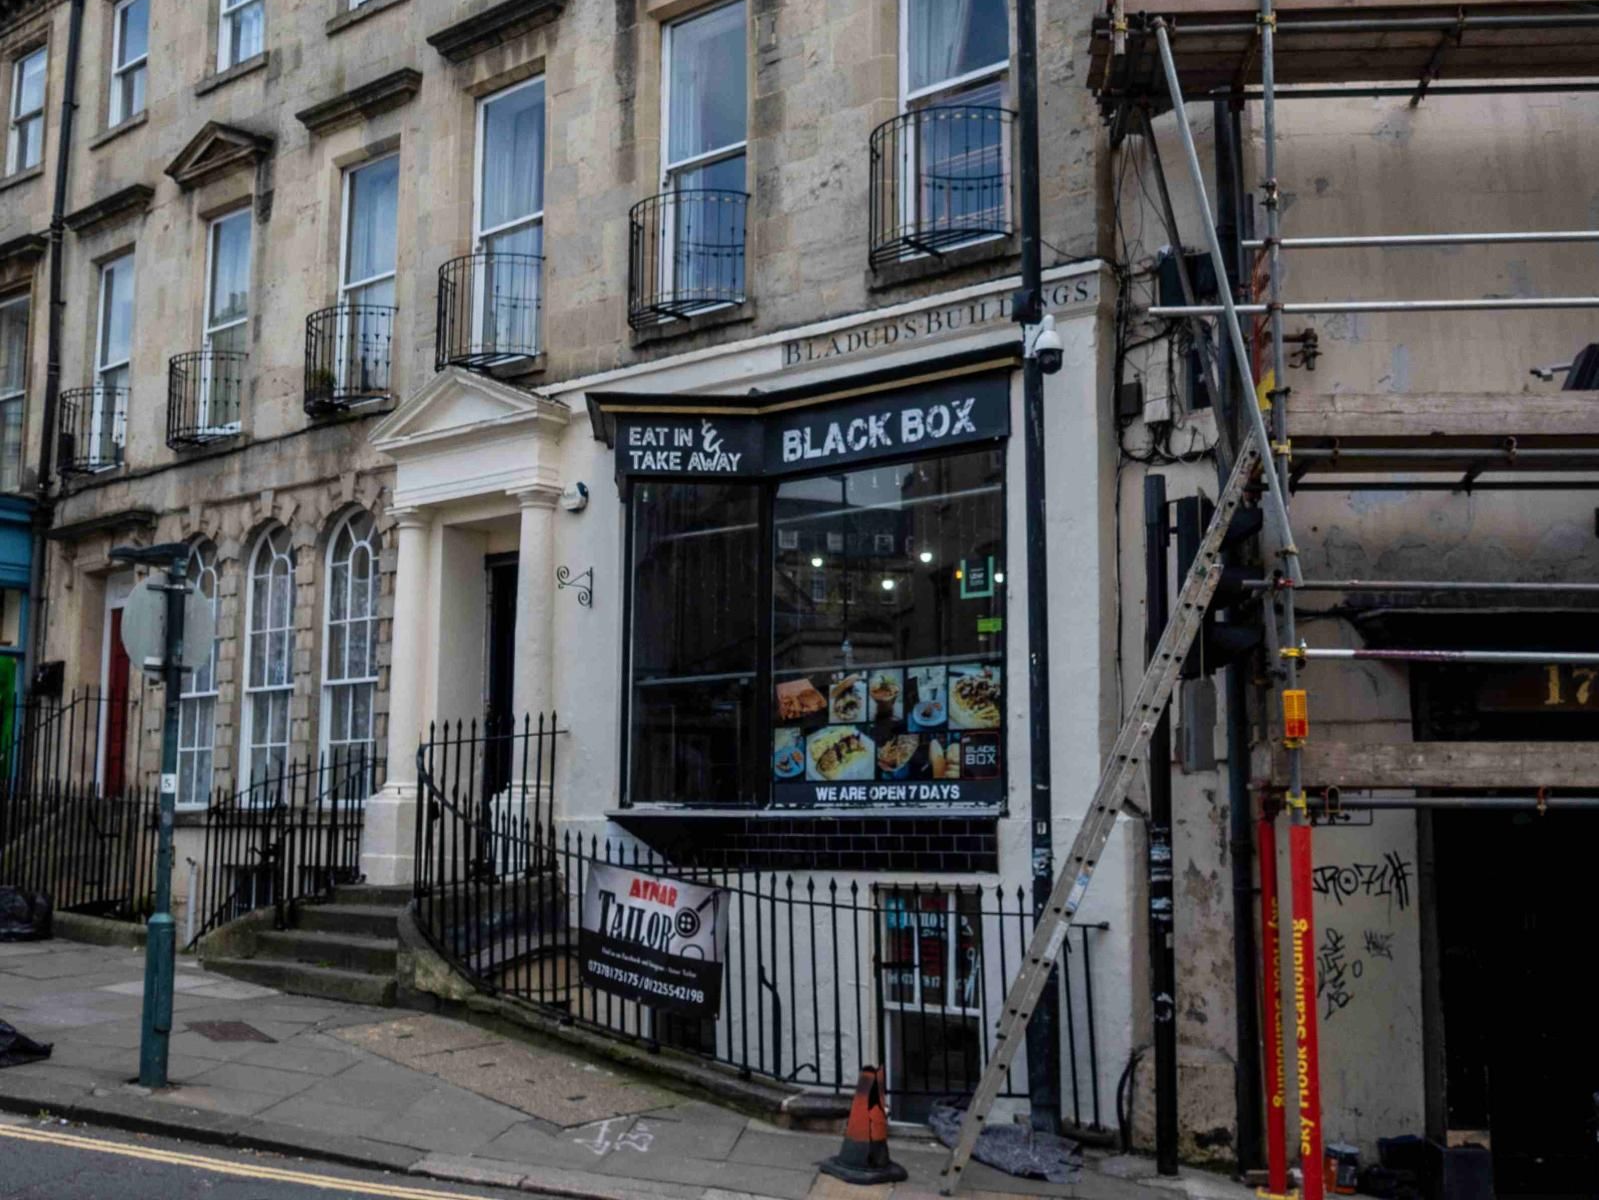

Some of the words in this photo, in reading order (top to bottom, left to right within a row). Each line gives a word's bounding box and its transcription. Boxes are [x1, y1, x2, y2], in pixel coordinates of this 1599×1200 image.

[629, 427, 668, 447] EAT
[674, 427, 693, 448] IN
[782, 412, 892, 463] BLACK
[901, 398, 977, 443] BOX
[629, 451, 681, 471] TAKE
[688, 452, 741, 472] AWAY
[965, 745, 996, 754] BLACK
[965, 754, 996, 766] BOX
[816, 787, 837, 801] WE
[839, 786, 866, 800] ARE
[869, 785, 906, 800] OPEN
[908, 785, 916, 799] 7
[920, 784, 961, 800] DAYS
[629, 878, 678, 907] AYNAR
[598, 889, 676, 953] TAILOR
